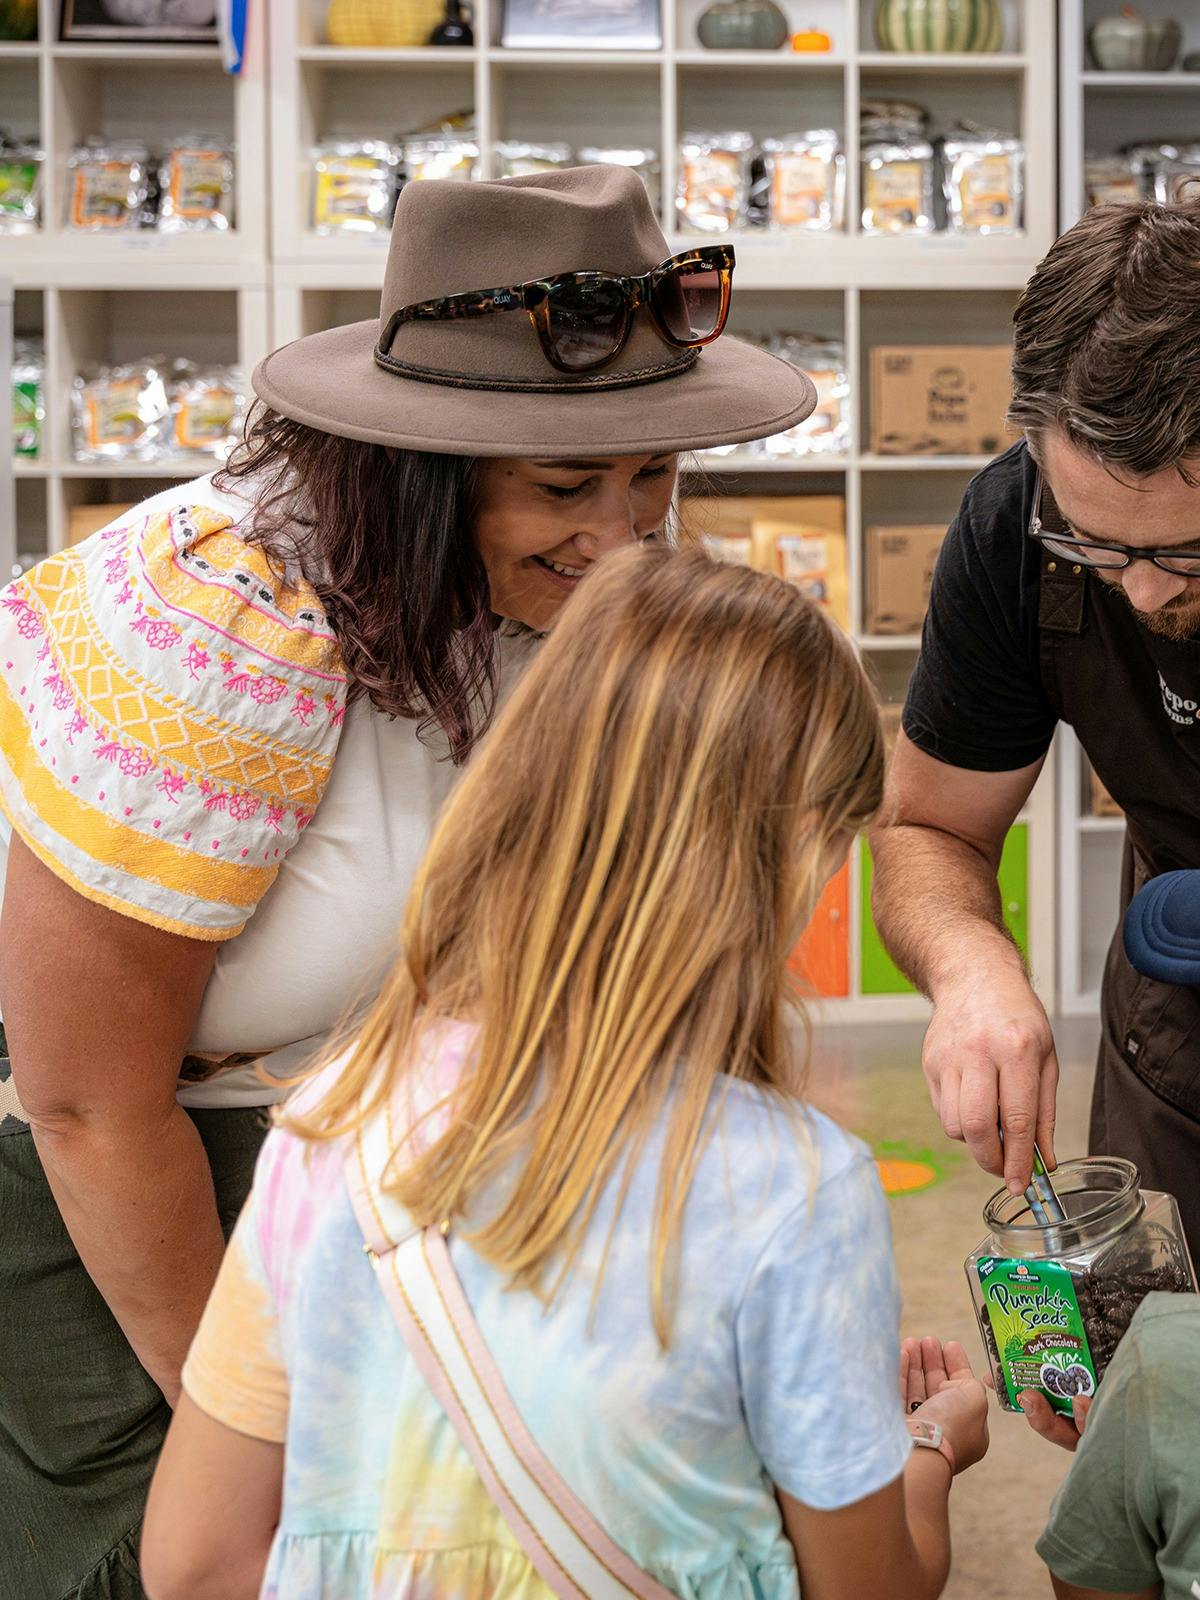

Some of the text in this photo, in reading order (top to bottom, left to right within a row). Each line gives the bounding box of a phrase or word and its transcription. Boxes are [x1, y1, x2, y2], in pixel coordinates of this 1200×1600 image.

[493, 295, 511, 305] QUAY
[989, 1282, 1074, 1316] Pumpkin
[1020, 1307, 1069, 1331] Seeds
[1027, 1341, 1046, 1354] Dark
[1045, 1338, 1079, 1349] Chocolate
